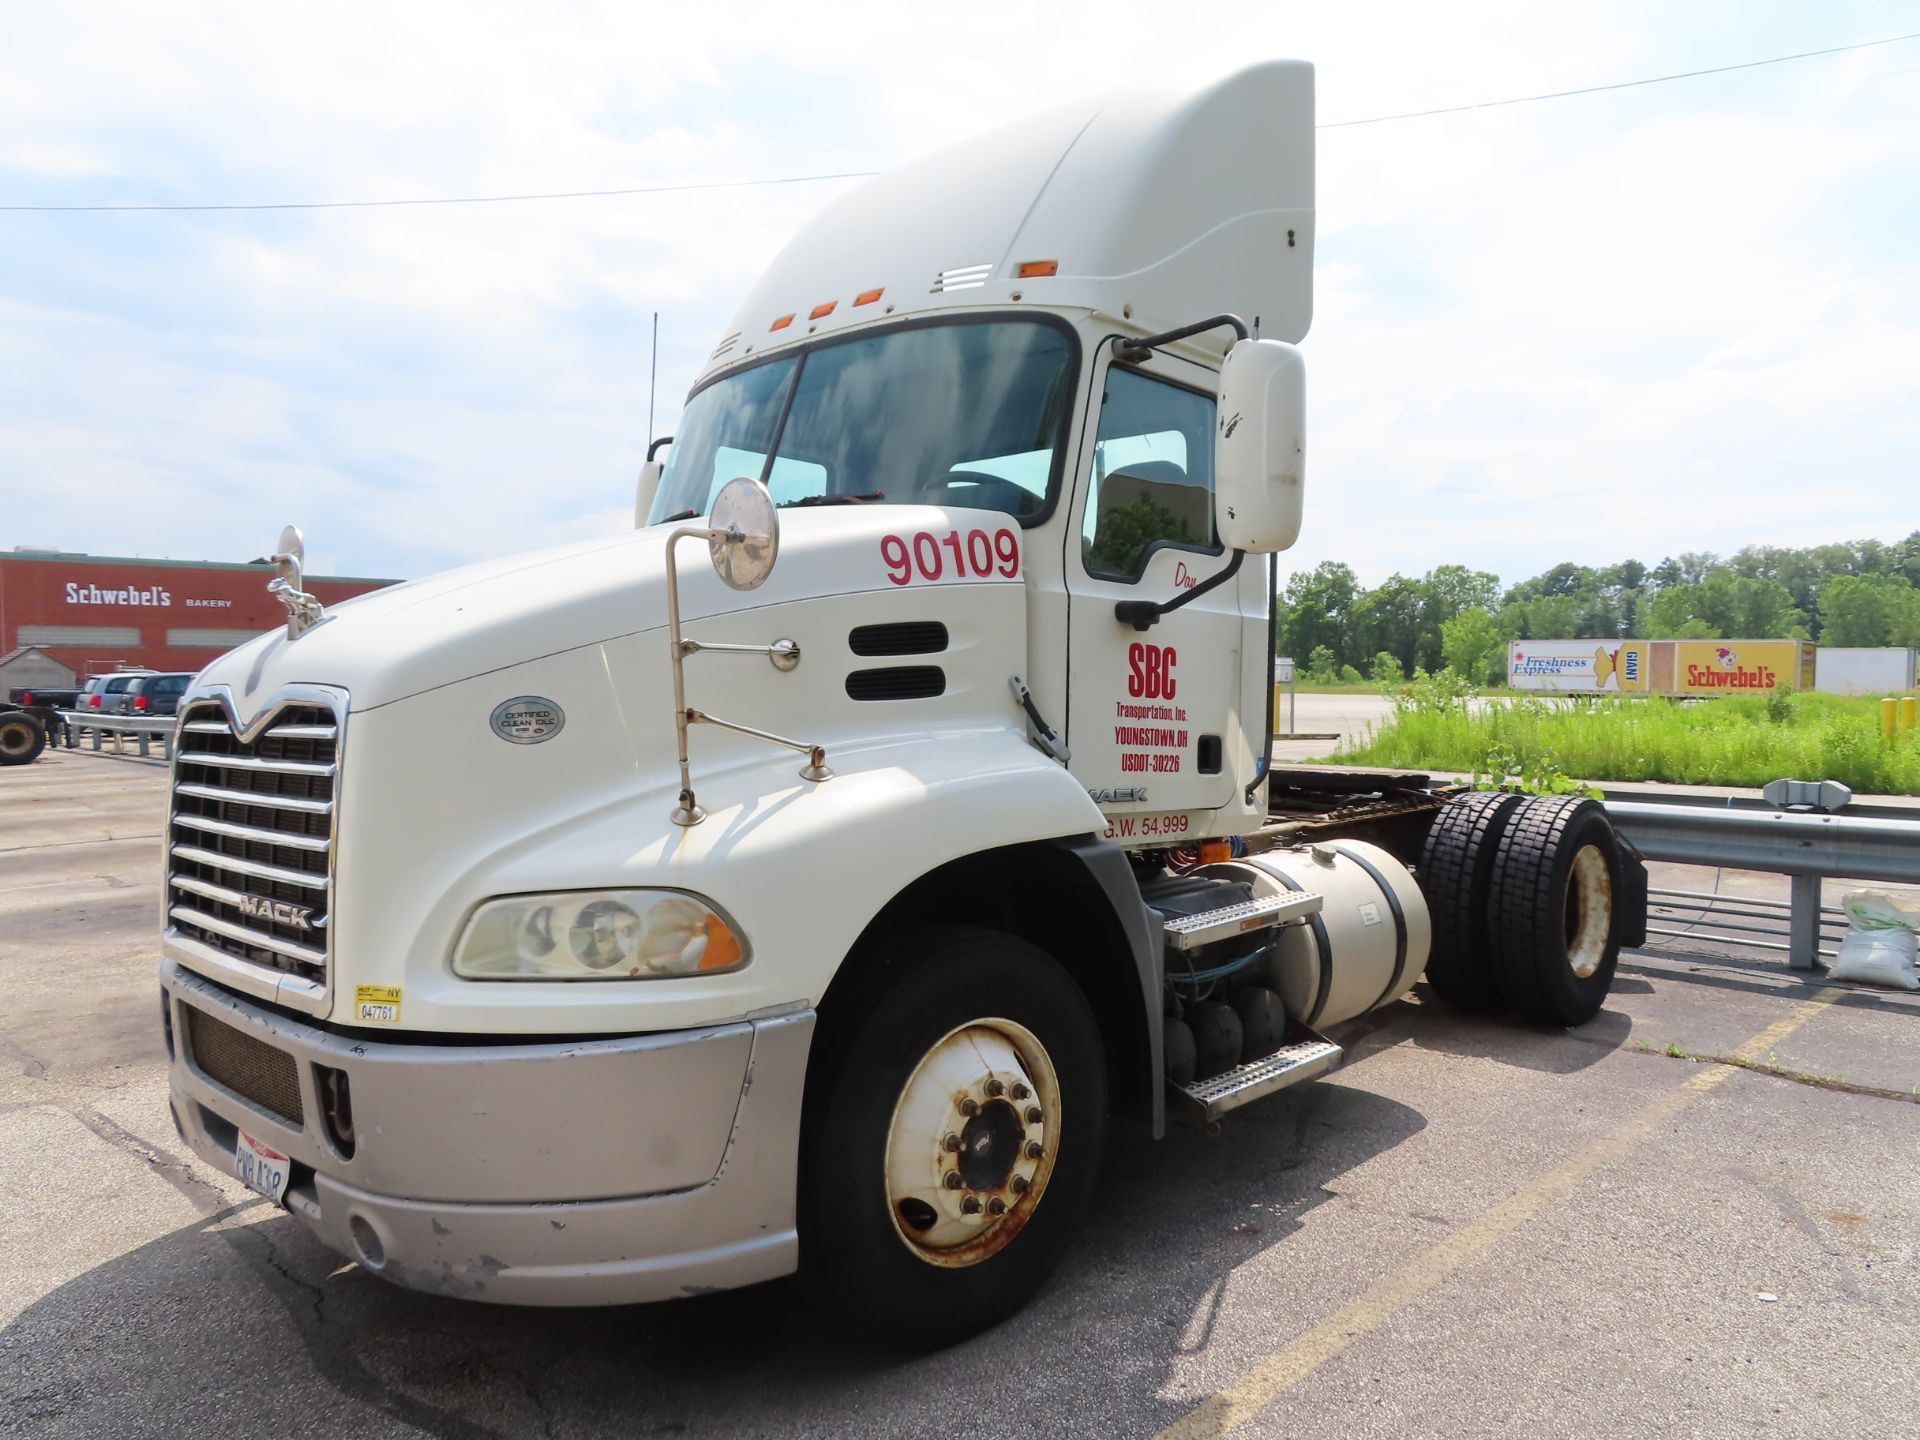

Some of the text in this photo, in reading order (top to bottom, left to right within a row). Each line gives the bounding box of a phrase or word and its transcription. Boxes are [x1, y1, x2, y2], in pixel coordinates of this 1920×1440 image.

[881, 528, 1019, 586] 90109
[65, 582, 232, 608] Schwebel's BAKERY
[1128, 642, 1177, 701] SBC
[1513, 663, 1561, 677] Express
[1525, 656, 1587, 668] Freshness
[1626, 651, 1639, 682] GIANT
[1687, 664, 1775, 689] Schwebel's
[505, 710, 550, 719] CERTIFIED
[1116, 702, 1188, 722] Transportation, Inc.
[501, 718, 555, 727] CLEAN IDLE
[1121, 753, 1180, 773] USDOT-30226
[1142, 815, 1189, 837] 54,999
[239, 895, 311, 929] MACK
[387, 988, 400, 998] NY
[361, 1004, 393, 1020] 047761
